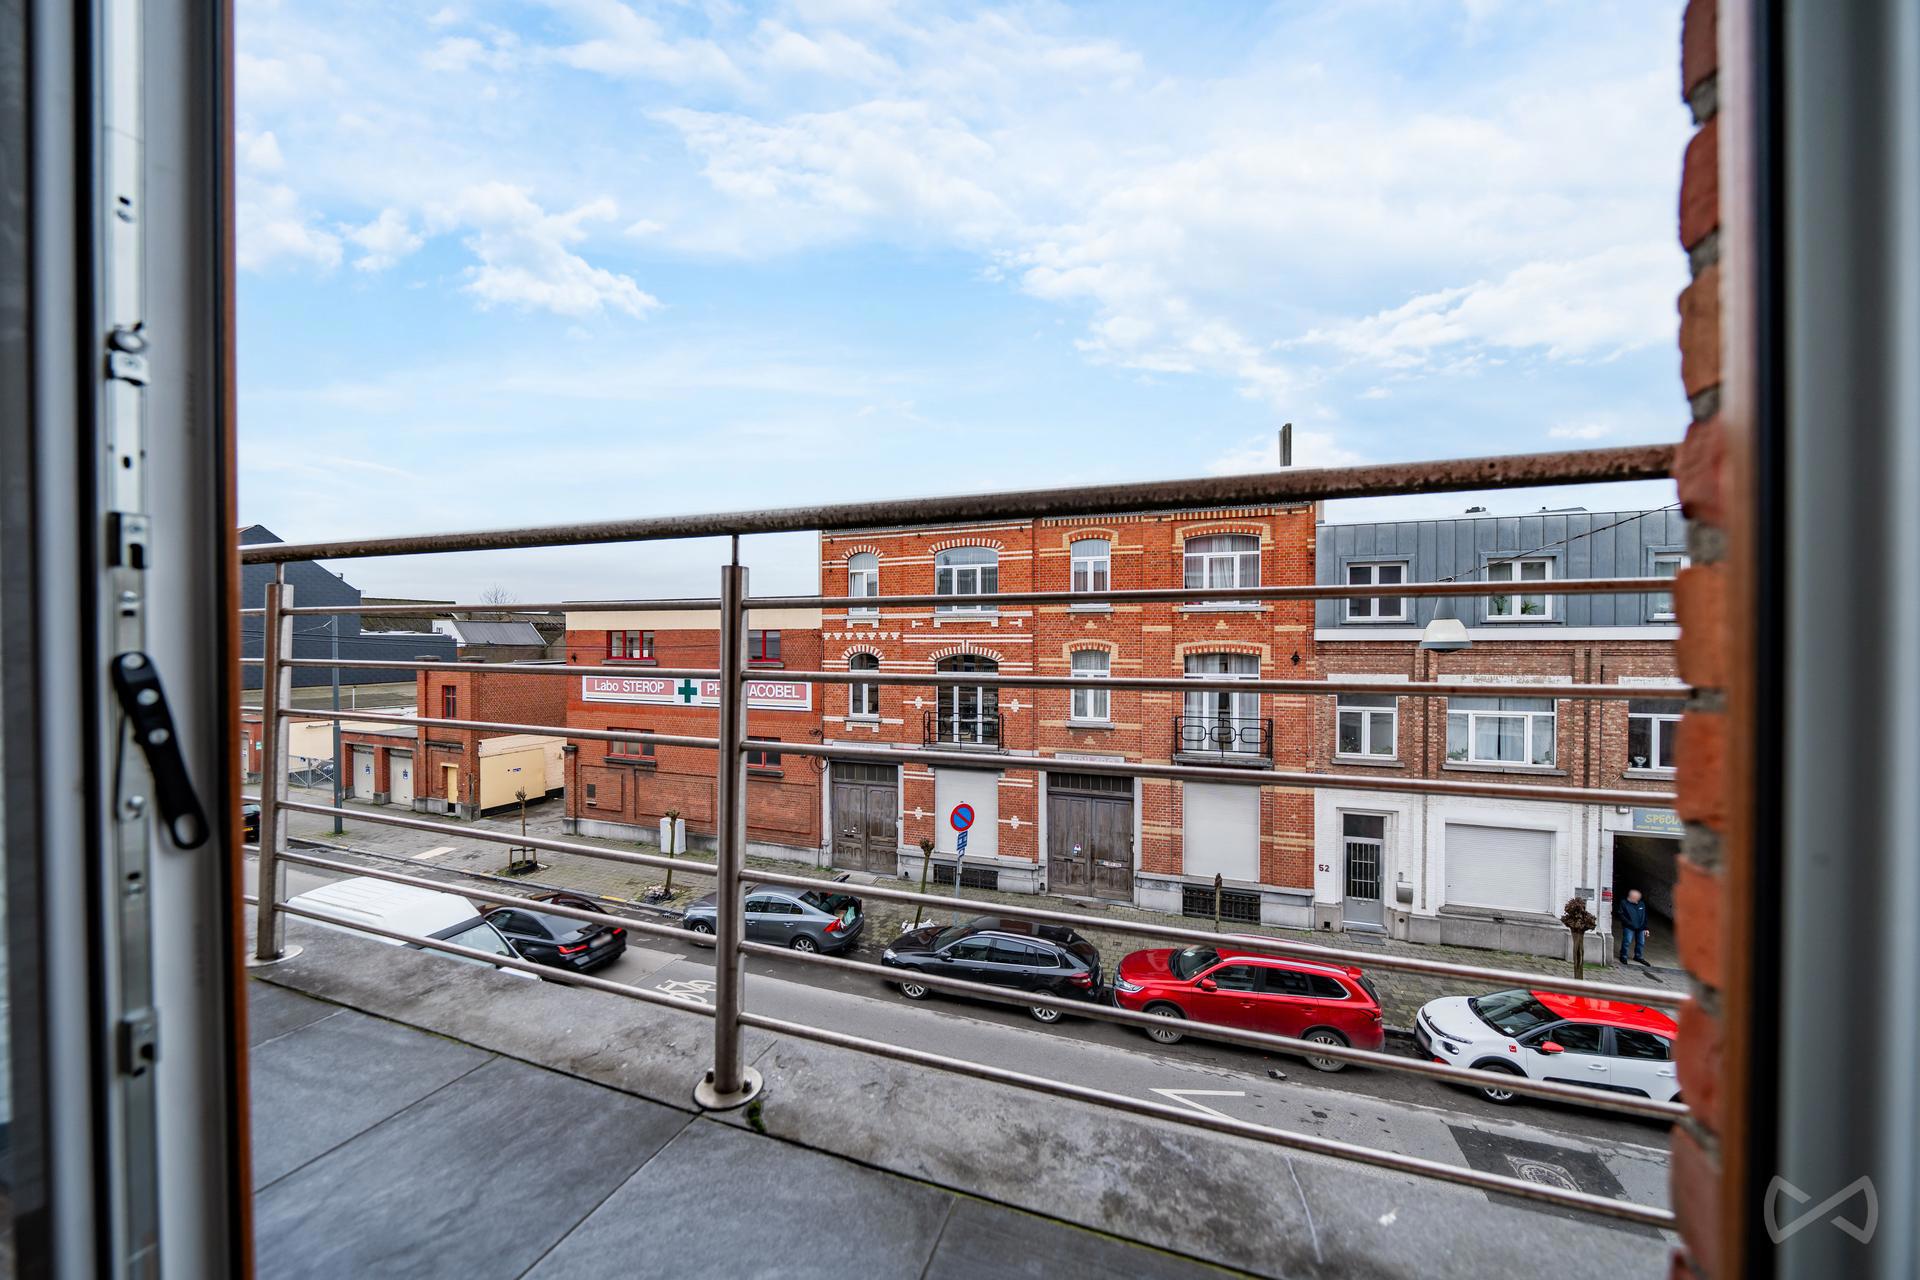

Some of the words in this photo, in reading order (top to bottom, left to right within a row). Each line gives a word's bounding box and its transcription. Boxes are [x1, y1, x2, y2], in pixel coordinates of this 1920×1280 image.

[594, 679, 619, 692] Labo
[622, 680, 665, 694] STEROP
[706, 682, 801, 699] PHACOBEL
[1318, 864, 1330, 872] 52
